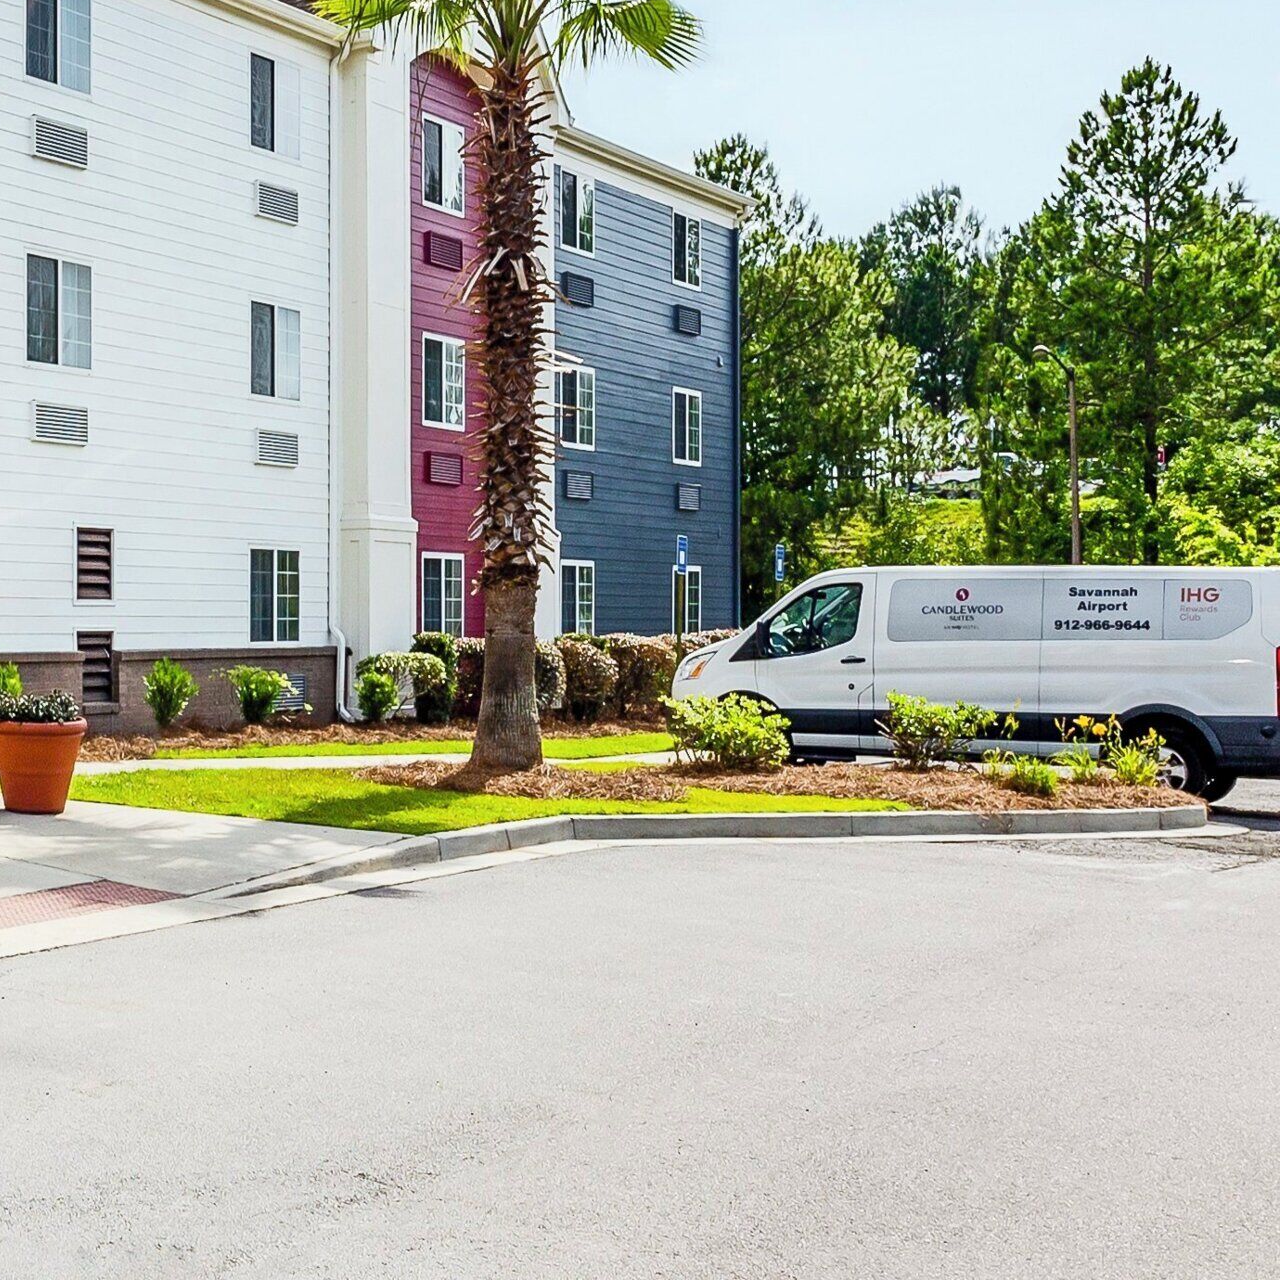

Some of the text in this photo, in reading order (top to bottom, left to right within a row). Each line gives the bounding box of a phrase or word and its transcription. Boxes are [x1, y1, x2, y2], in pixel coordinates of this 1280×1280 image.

[1068, 586, 1138, 597] Savannah
[1181, 587, 1220, 602] IHG
[921, 605, 1004, 615] CANDLEWOOD
[1077, 600, 1128, 613] Airport
[1180, 605, 1218, 613] Rewards
[1179, 613, 1201, 622] Club
[1054, 619, 1151, 631] 912-966-9644
